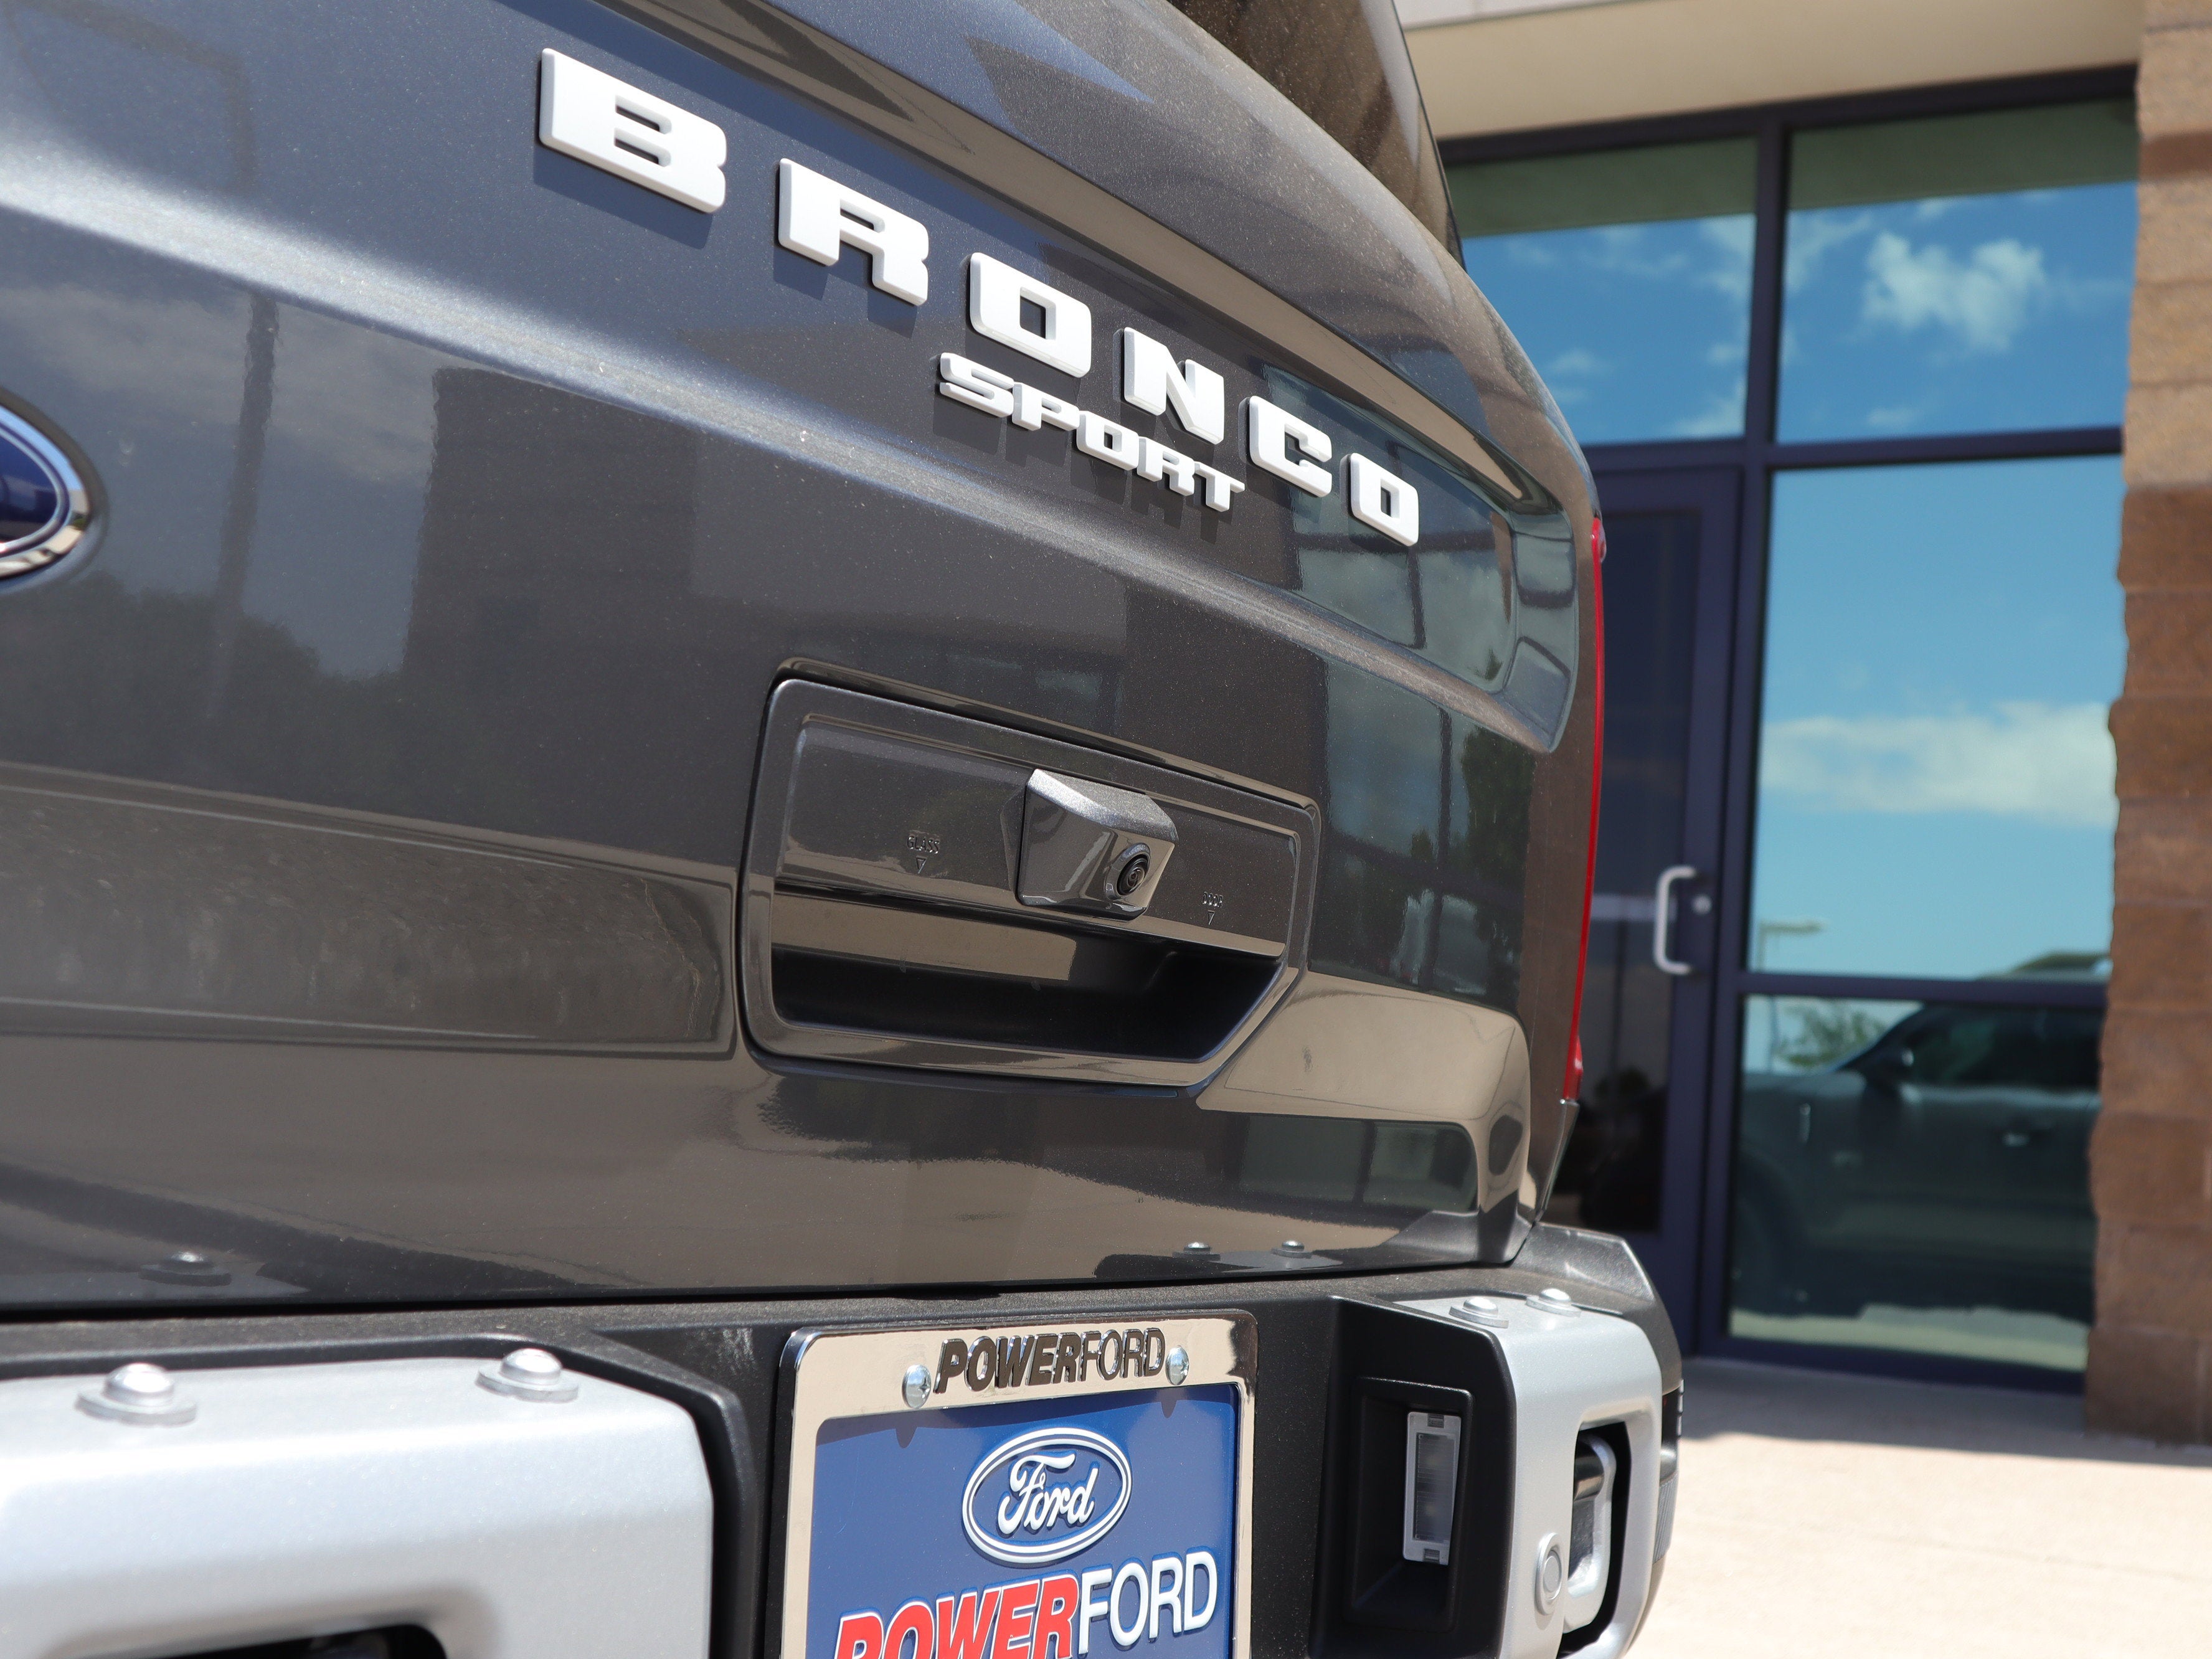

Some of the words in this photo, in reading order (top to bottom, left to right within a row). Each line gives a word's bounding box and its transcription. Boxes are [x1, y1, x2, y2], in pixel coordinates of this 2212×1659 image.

[539, 47, 1419, 547] BRONCO
[939, 352, 1245, 513] SPORT
[907, 833, 940, 854] GLASS
[932, 1327, 1166, 1394] POWERFORD
[998, 1453, 1099, 1534] Ford
